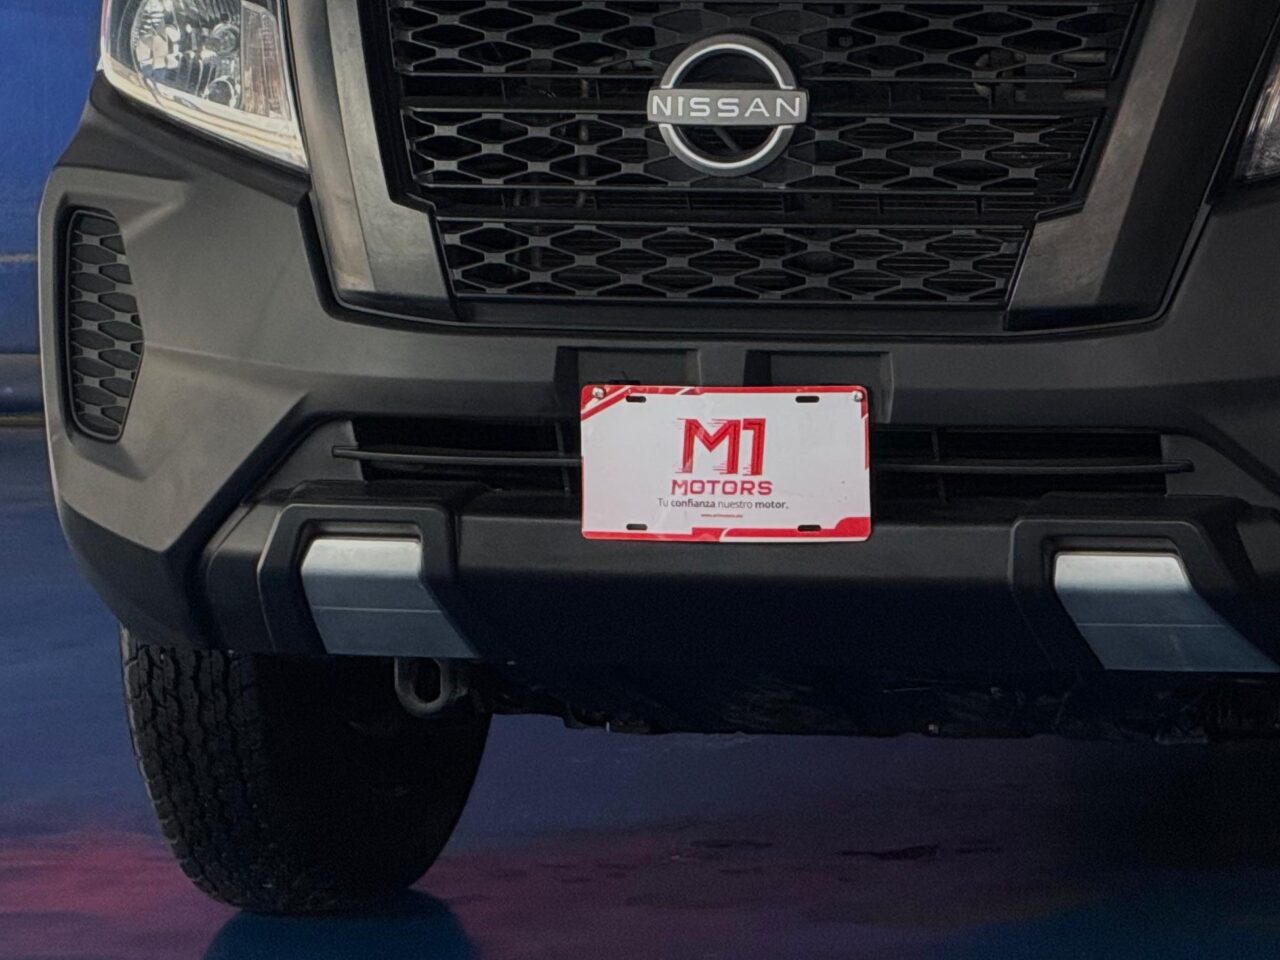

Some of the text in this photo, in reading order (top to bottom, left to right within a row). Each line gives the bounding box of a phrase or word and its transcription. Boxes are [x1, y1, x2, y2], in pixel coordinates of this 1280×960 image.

[652, 95, 800, 117] NISSAN
[675, 418, 766, 476] M1
[671, 479, 773, 496] MOTORS
[657, 497, 789, 510] Tu confianza nuestro motor.
